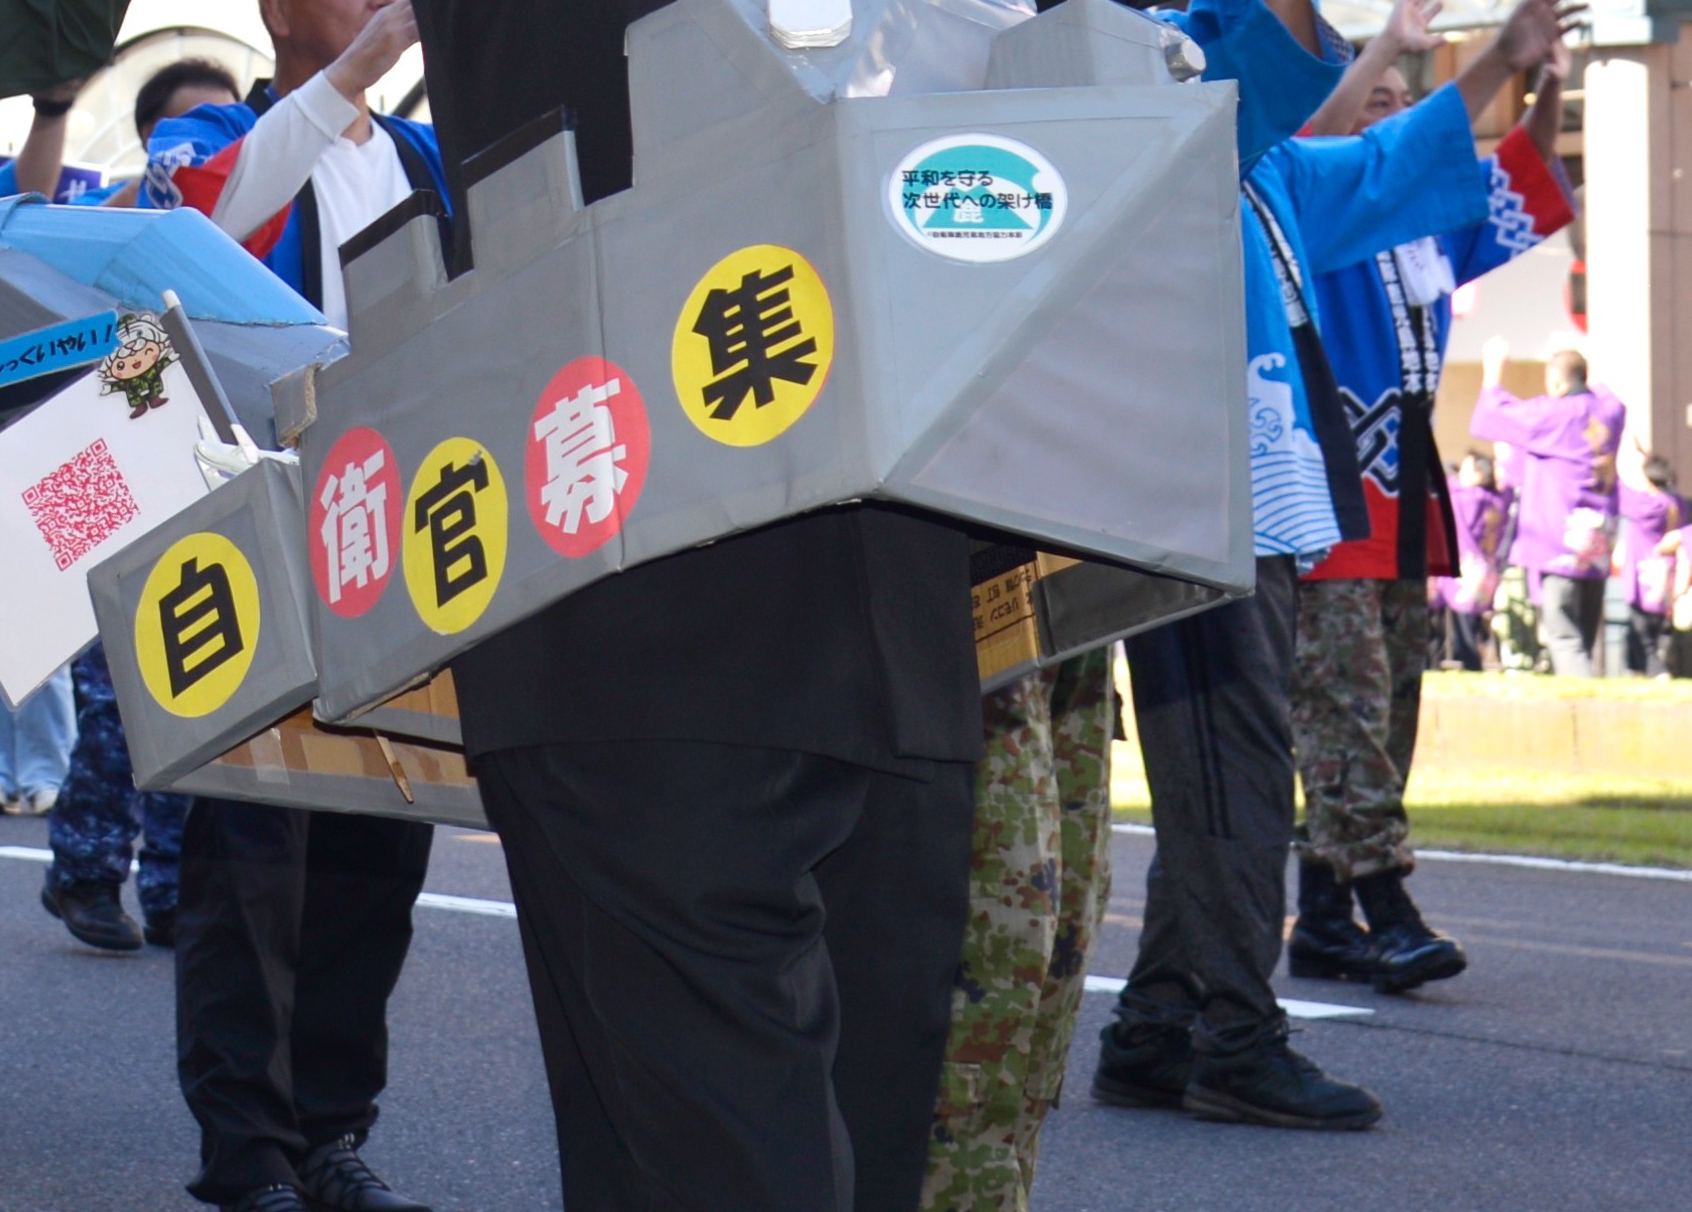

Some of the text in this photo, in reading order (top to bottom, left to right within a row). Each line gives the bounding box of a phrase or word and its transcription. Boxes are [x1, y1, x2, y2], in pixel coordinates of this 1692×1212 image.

[901, 169, 994, 187] 平和を守る
[901, 191, 1054, 211] 次世代への架け橋
